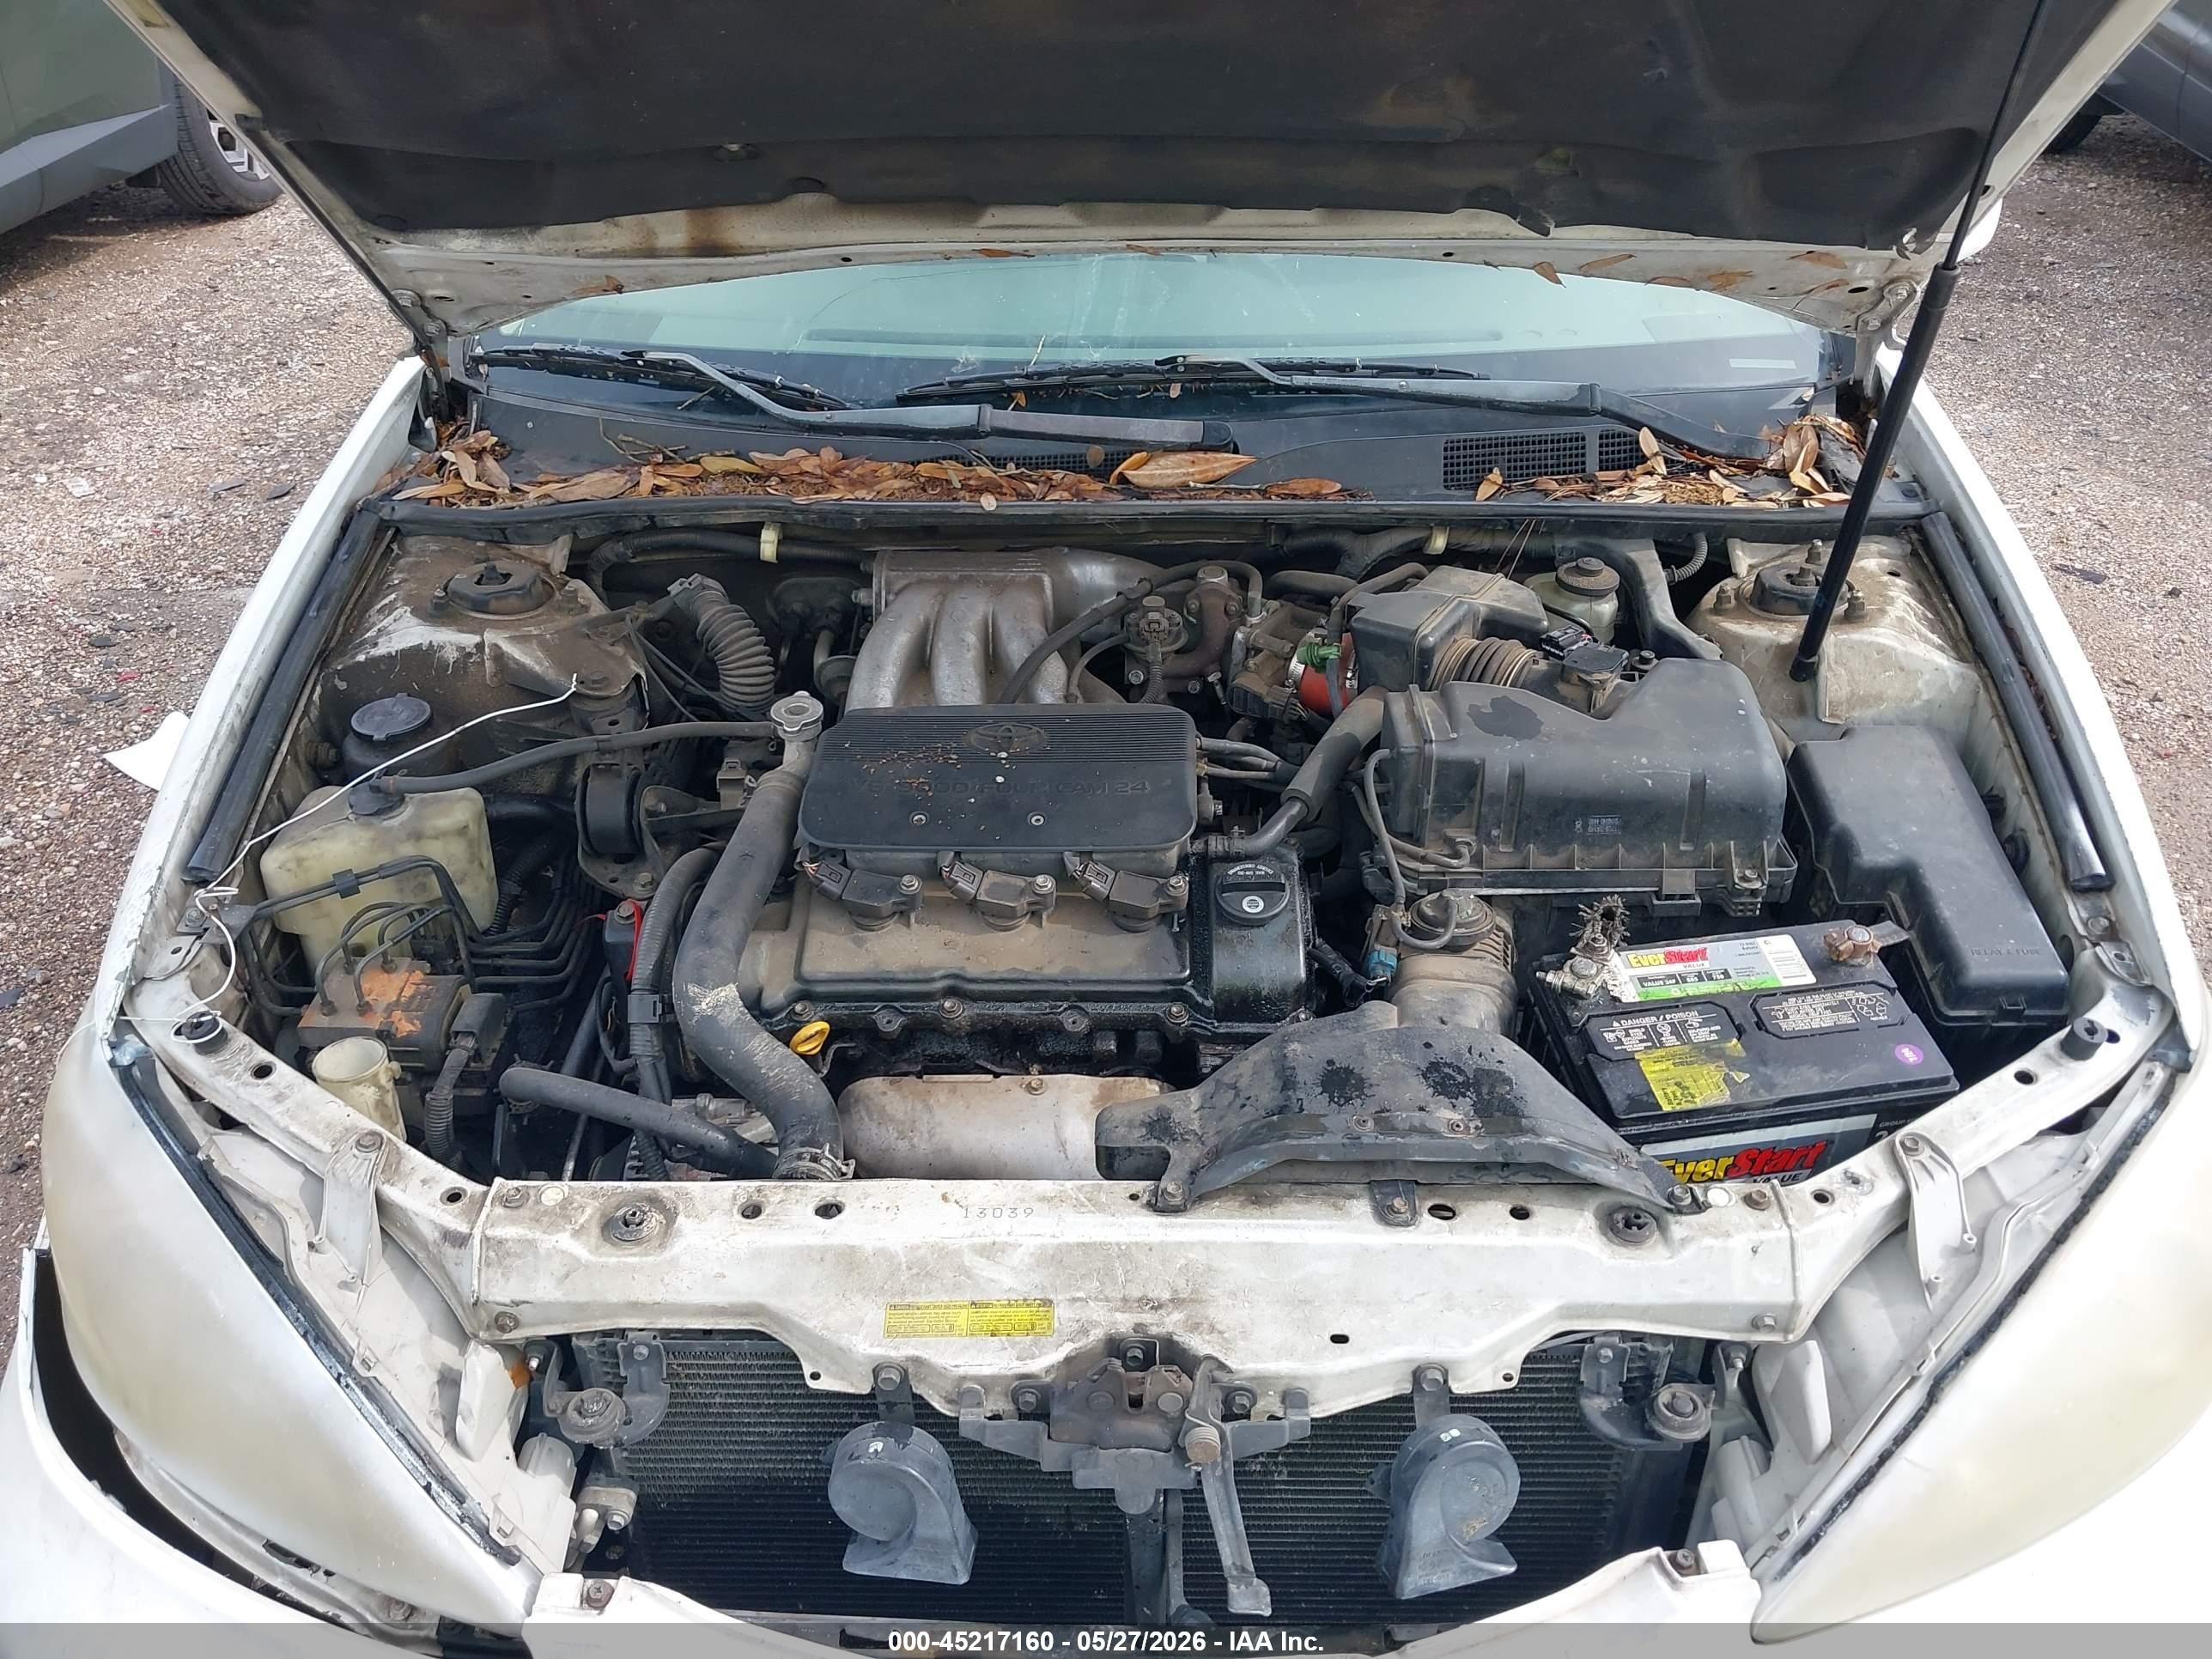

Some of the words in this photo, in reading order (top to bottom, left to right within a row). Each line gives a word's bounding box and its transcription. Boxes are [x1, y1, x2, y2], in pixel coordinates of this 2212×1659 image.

[1058, 781, 1109, 795] CAM
[1115, 780, 1148, 795] 24
[1626, 946, 1709, 969] EverStart
[1620, 1016, 1658, 1027] DANGER
[1666, 1010, 1698, 1021] POISON
[963, 1207, 1034, 1218] 13039
